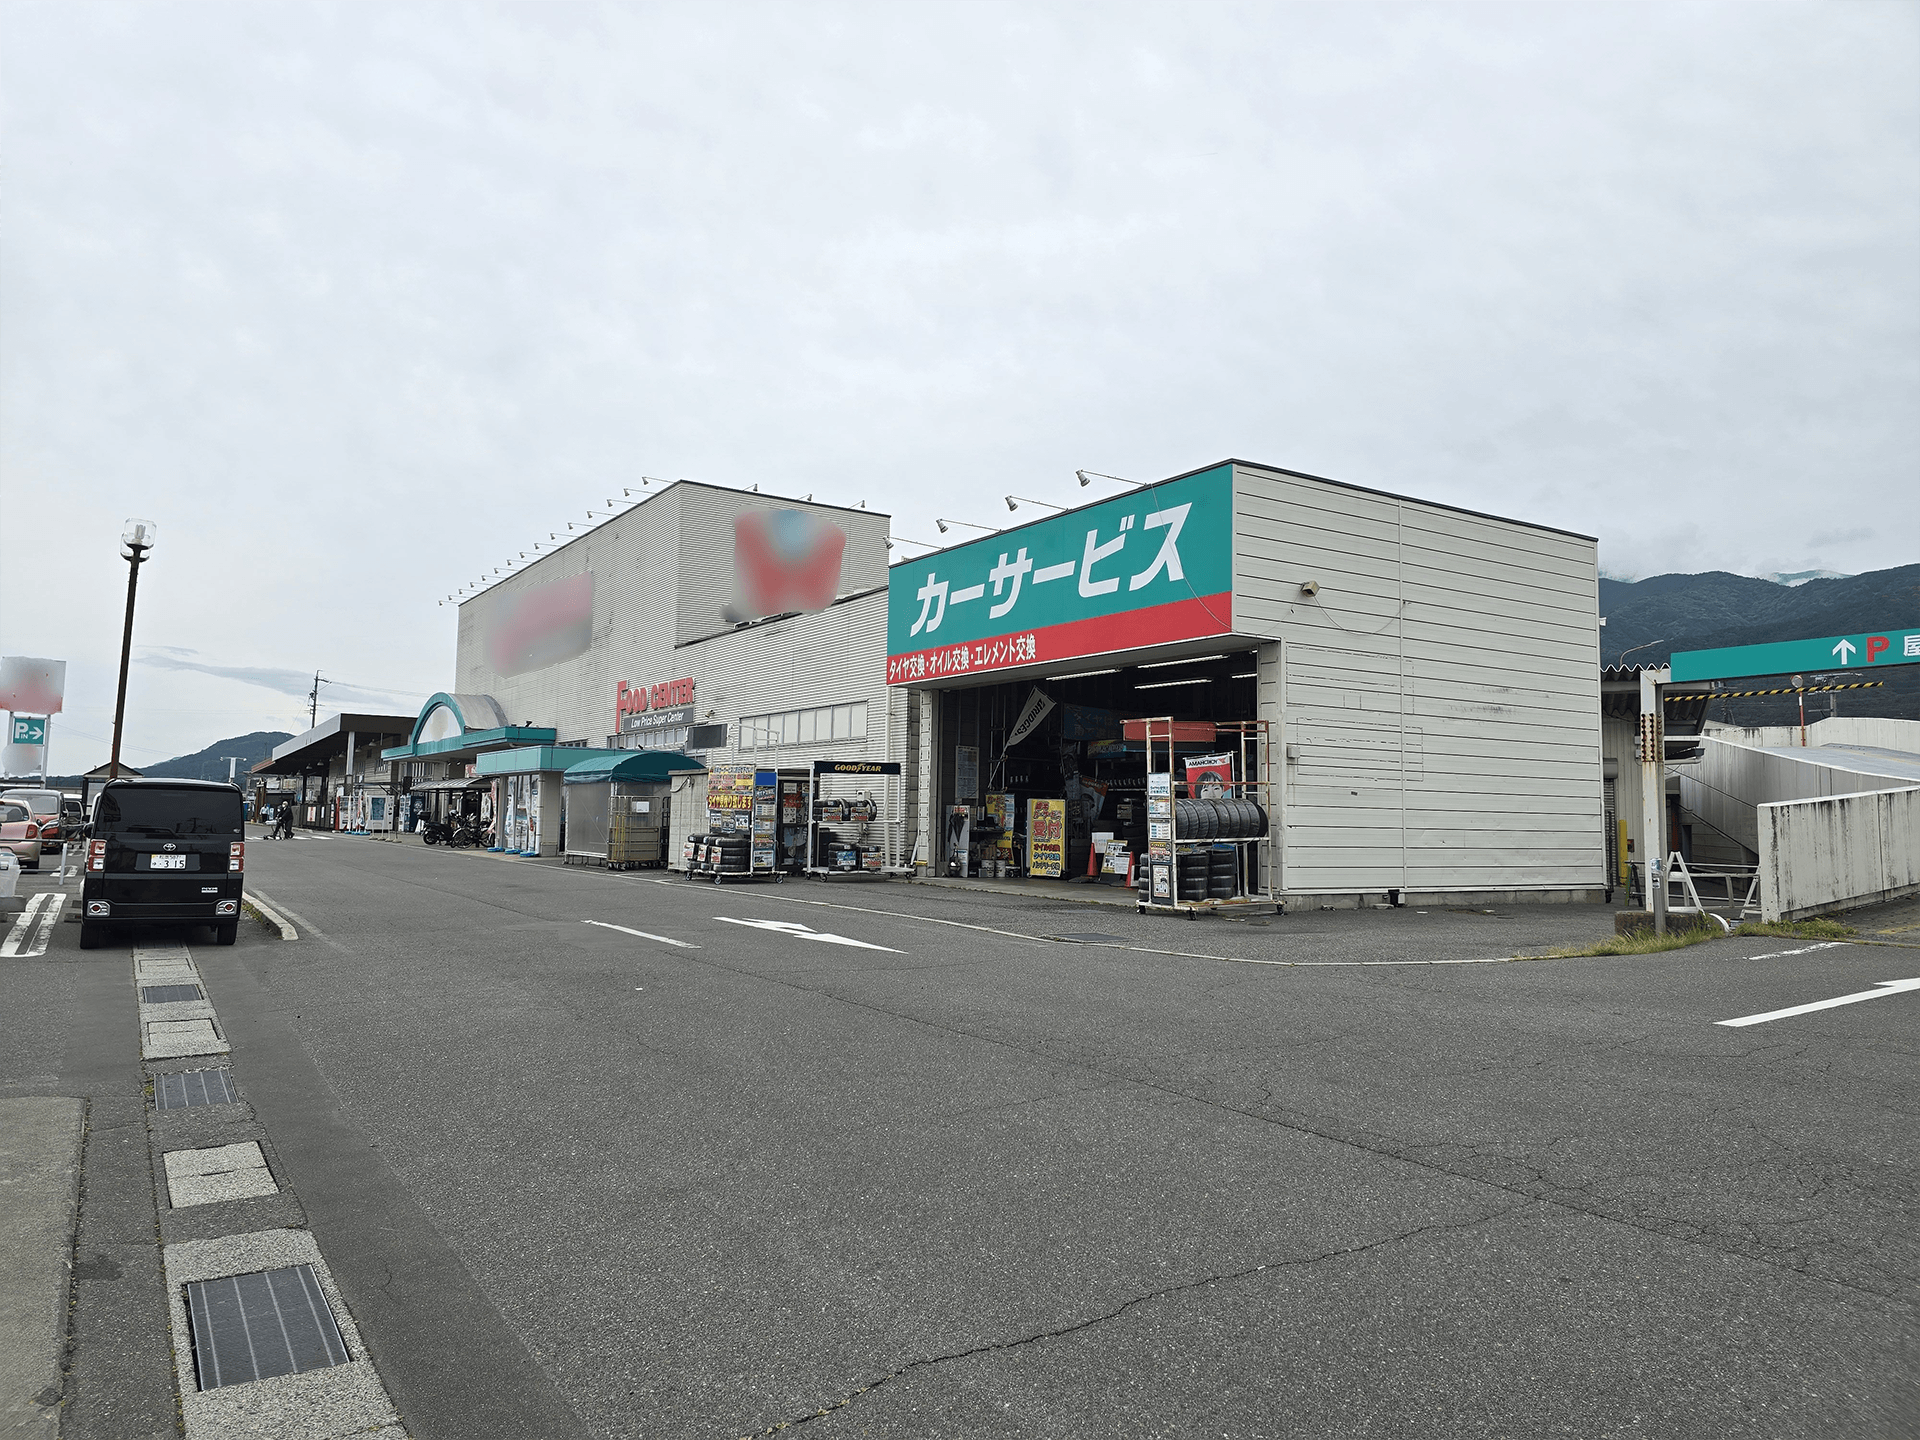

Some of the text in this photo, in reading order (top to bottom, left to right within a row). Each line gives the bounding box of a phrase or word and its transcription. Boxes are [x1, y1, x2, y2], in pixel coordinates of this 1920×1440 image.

[910, 502, 1192, 637] カーサービス
[889, 633, 1036, 680] タイヤ交換・オイル交換・エレメント交換
[1867, 636, 1890, 663] P
[615, 677, 694, 734] FOOD CENTER
[631, 711, 684, 728] Low Price Super Center
[1014, 698, 1046, 736] BRIDGES
[15, 722, 29, 739] P
[834, 763, 882, 773] GOODYEAR
